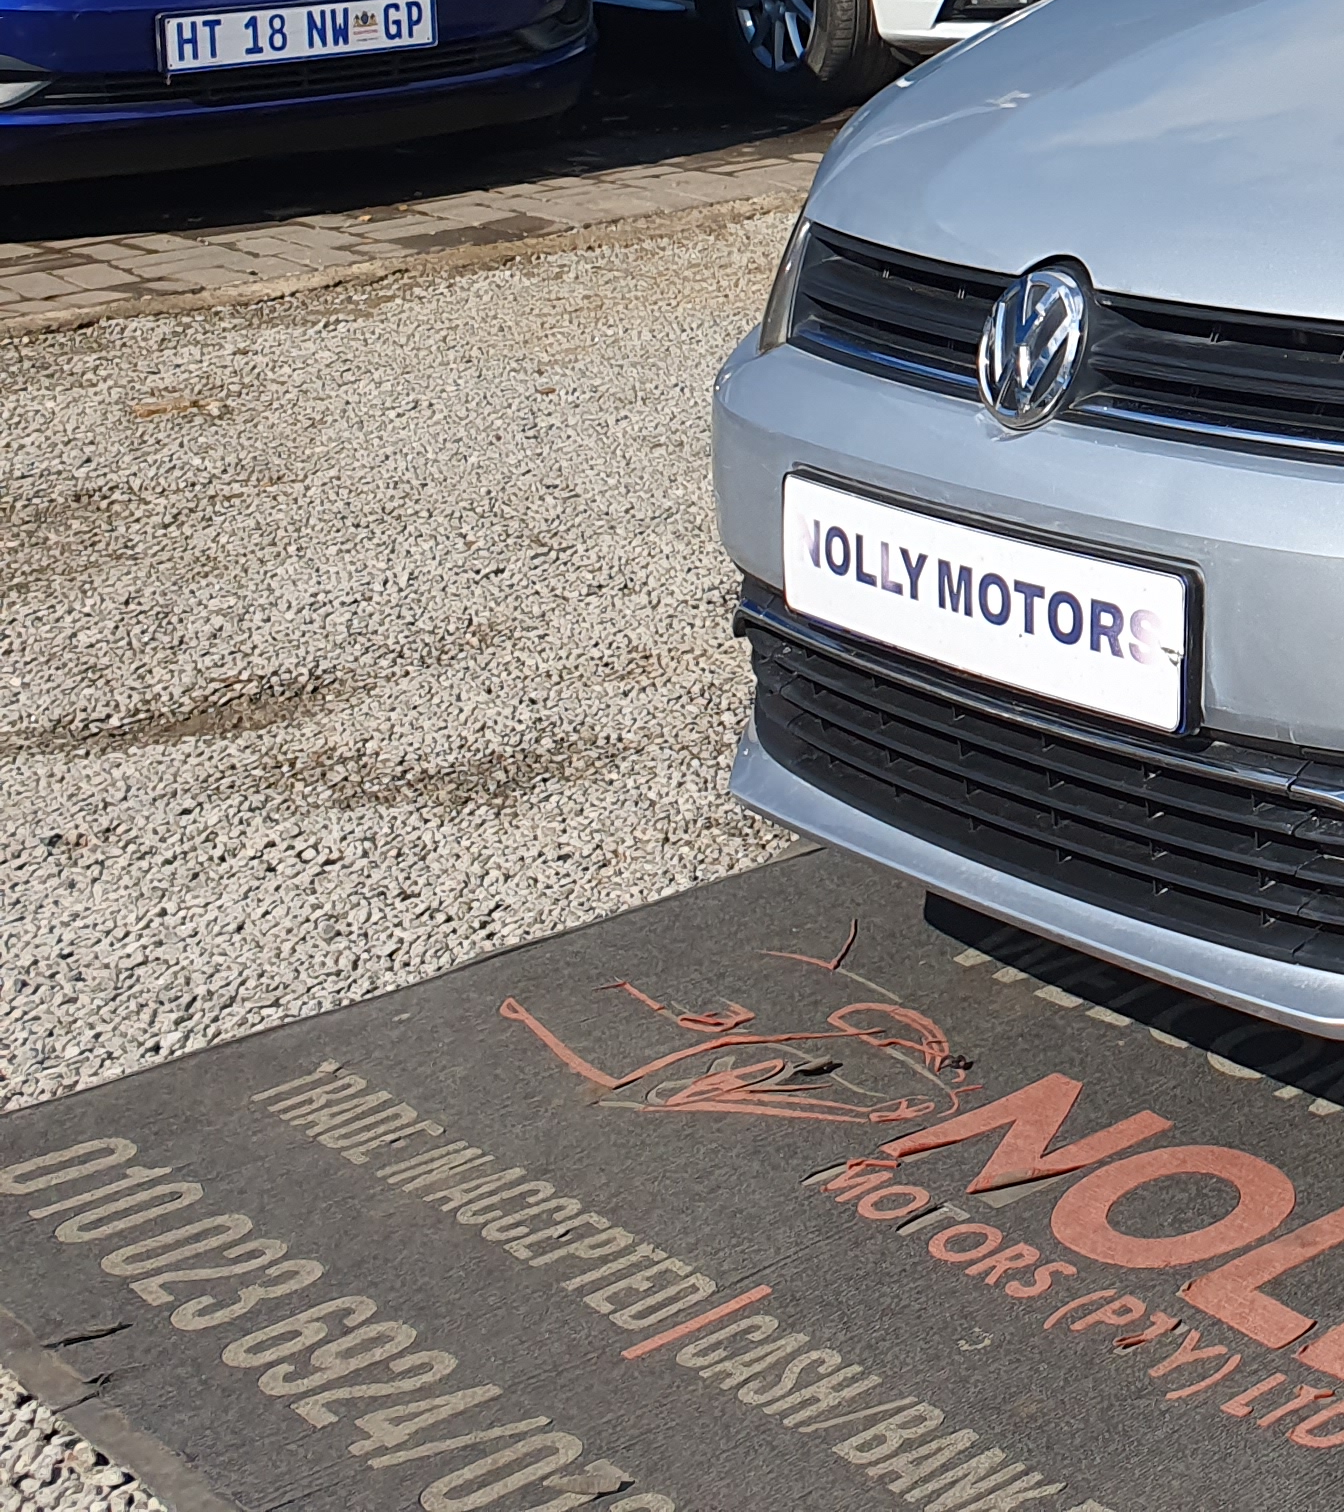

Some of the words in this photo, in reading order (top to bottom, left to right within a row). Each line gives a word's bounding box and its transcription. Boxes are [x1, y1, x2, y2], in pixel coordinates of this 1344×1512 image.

[176, 19, 222, 62] HT
[244, 13, 288, 55] 18
[306, 6, 350, 49] NW
[383, 0, 423, 41] GP
[798, 514, 929, 601] NOLLY
[937, 559, 1166, 666] MOTORS
[250, 1058, 446, 1165] TRADE
[422, 1167, 718, 1331] ACCEPTED
[800, 1158, 1078, 1299] MOTORS
[1043, 1288, 1242, 1400] (PTY)
